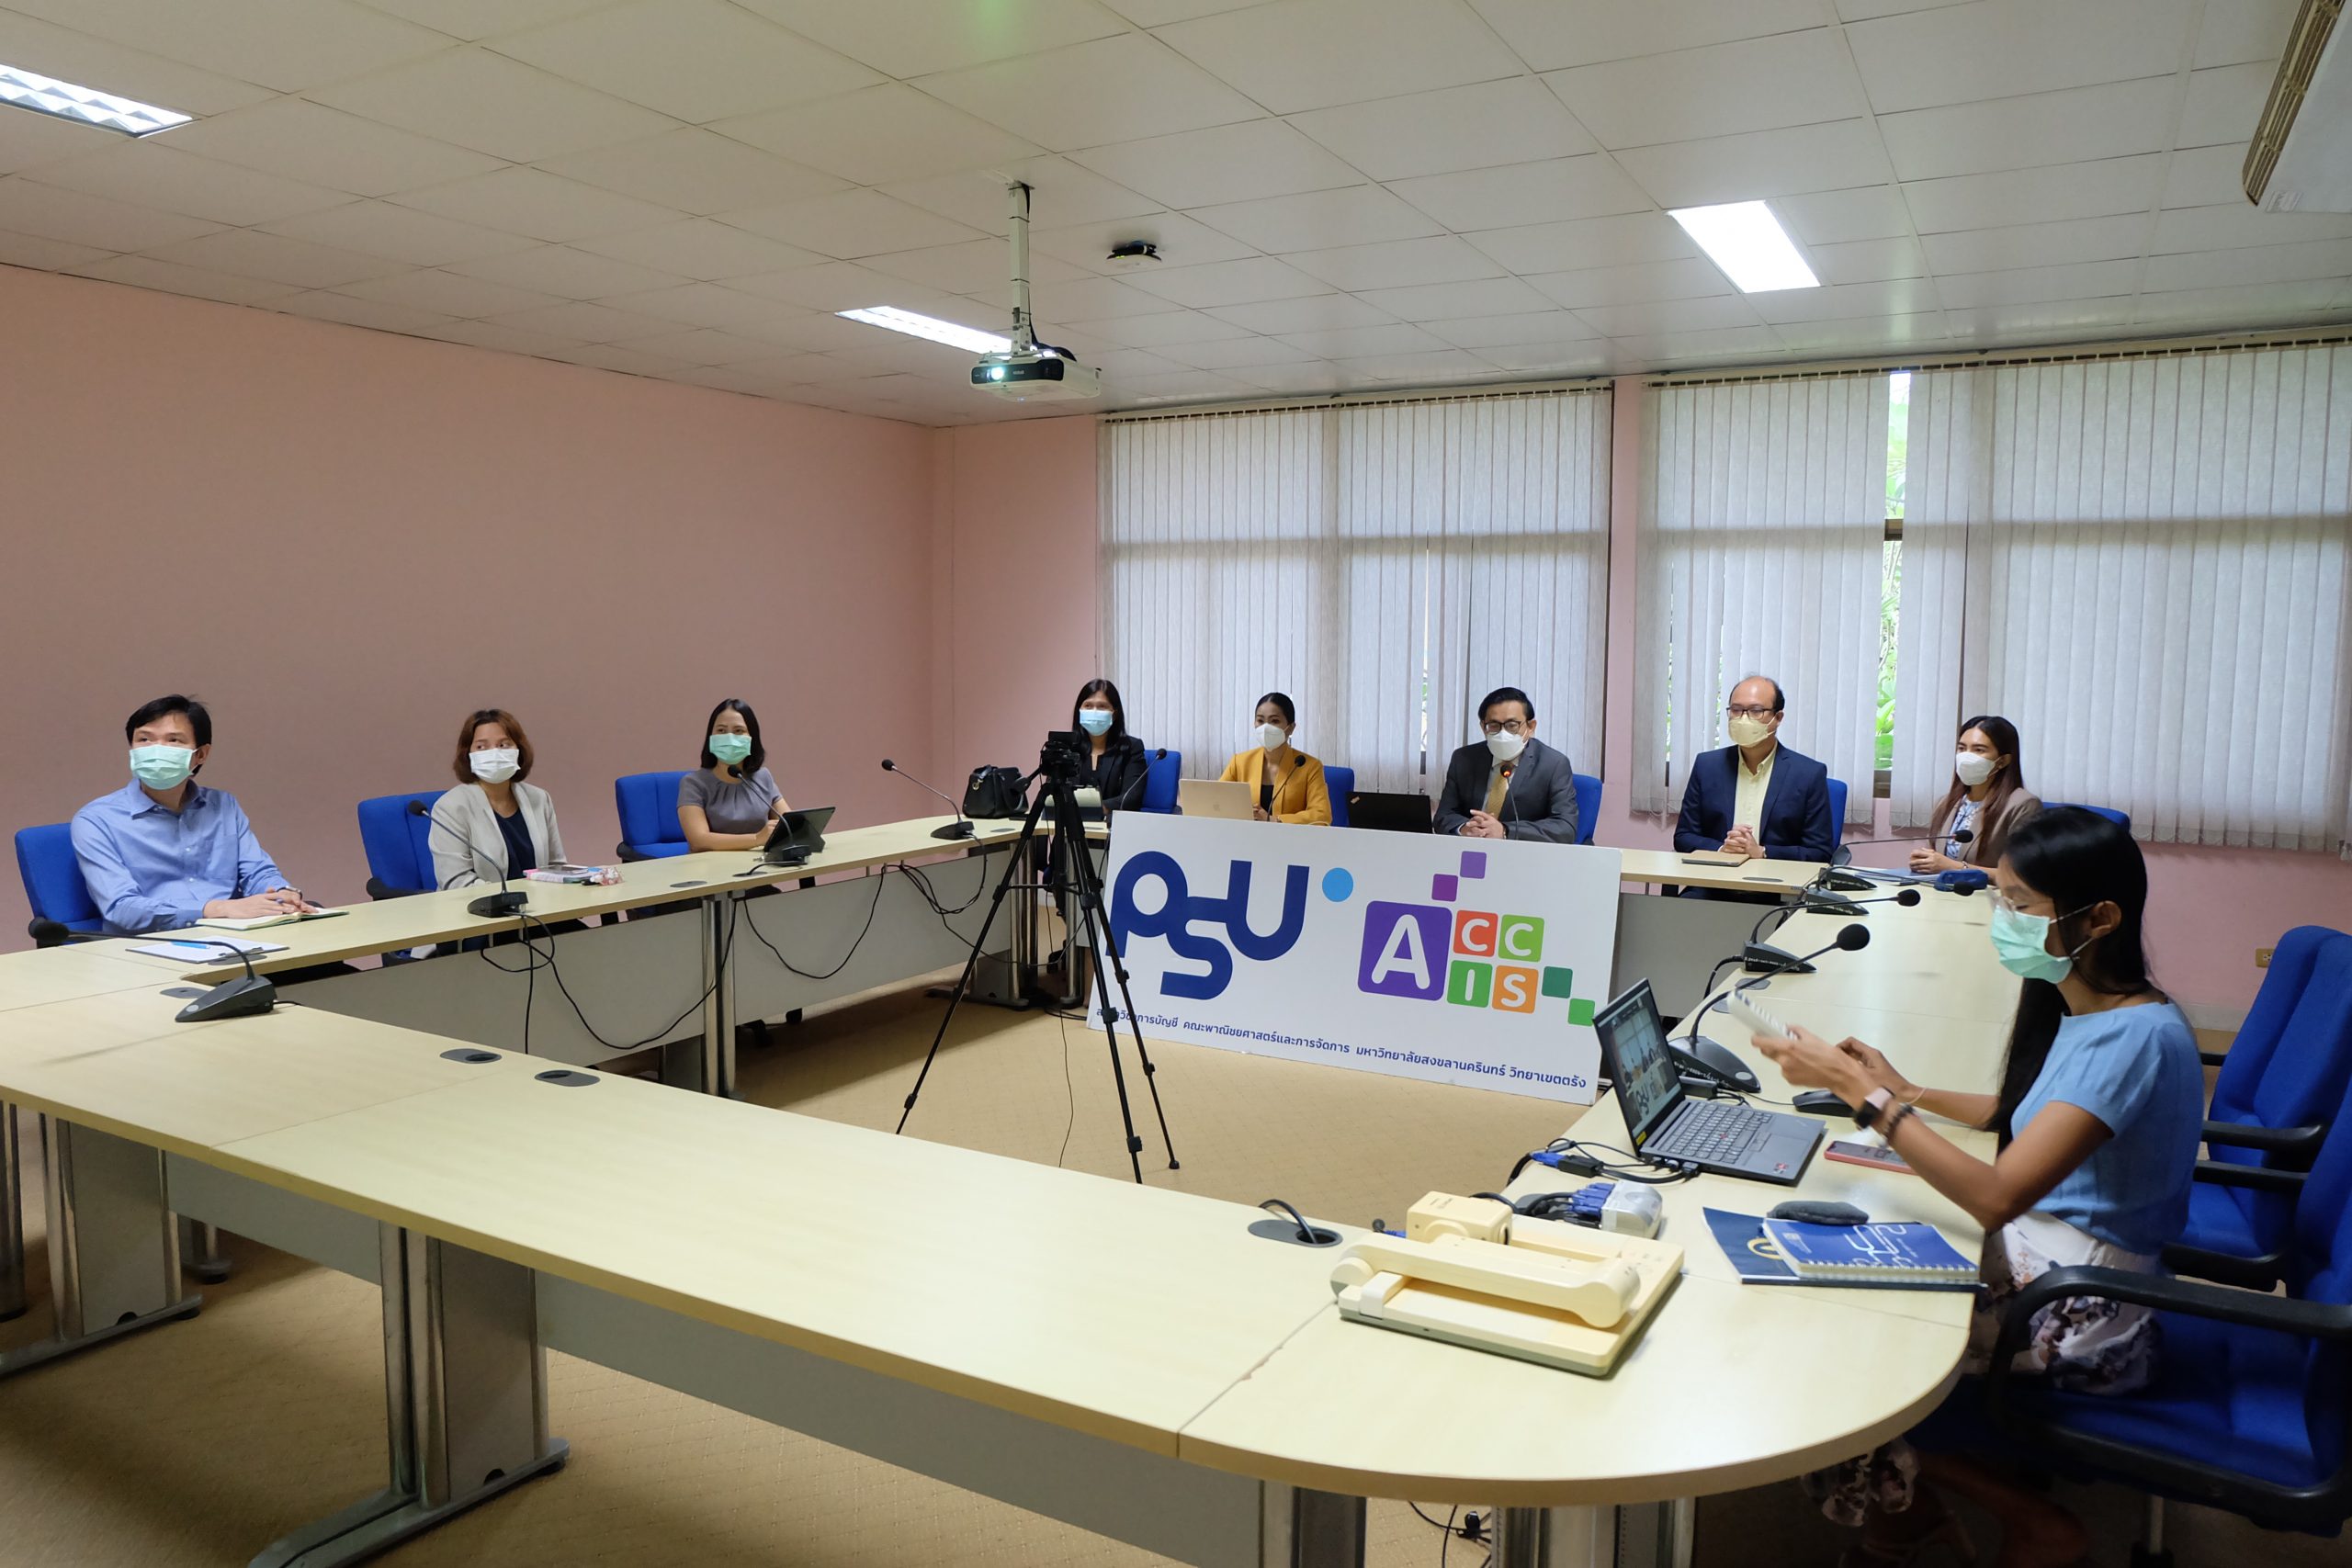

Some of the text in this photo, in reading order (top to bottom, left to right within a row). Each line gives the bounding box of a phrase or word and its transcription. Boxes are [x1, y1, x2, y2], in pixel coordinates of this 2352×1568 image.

[1105, 852, 1309, 1000] PSU
[1183, 1021, 1350, 1054] คณะพาณิชยศาสตร์และการจัดการ
[1355, 1044, 1506, 1076] มหาวิทยาลัยสงขลานครินทร์
[1510, 1066, 1587, 1089] วิทยาเขตตรัง
